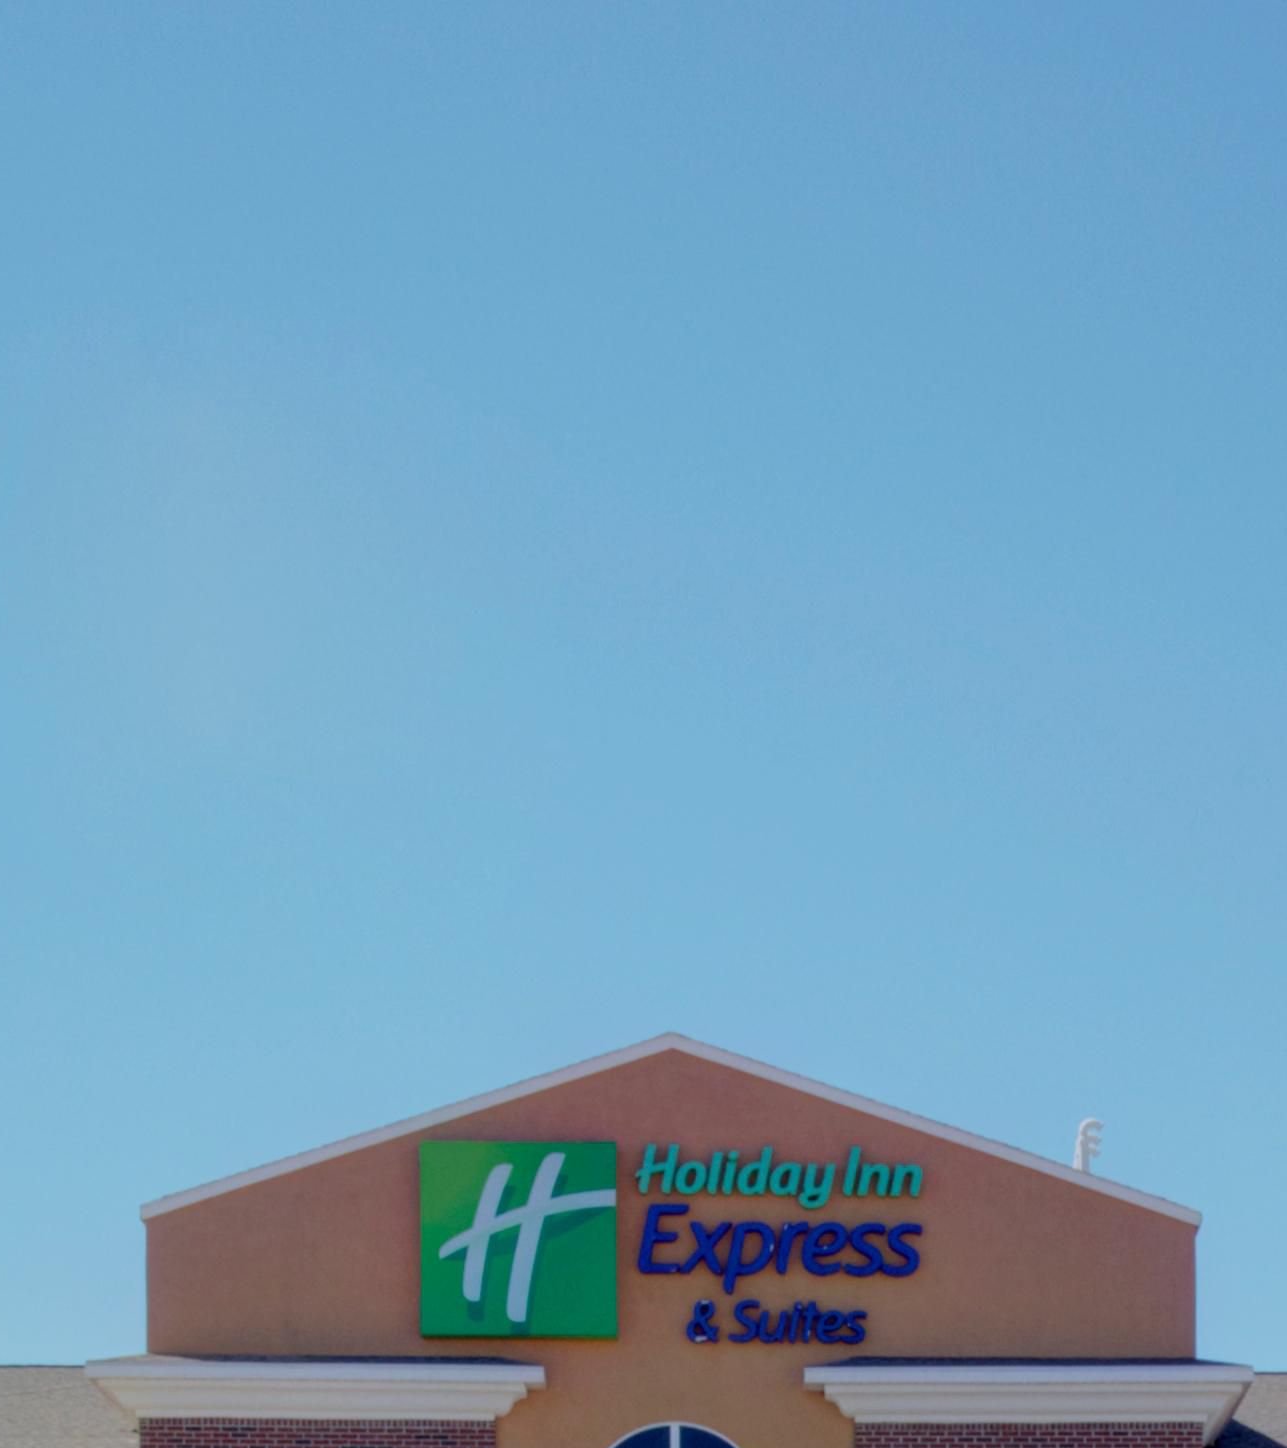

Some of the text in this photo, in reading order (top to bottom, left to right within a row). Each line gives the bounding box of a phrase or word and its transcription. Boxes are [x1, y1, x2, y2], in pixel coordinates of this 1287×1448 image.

[636, 1143, 924, 1209] Holiday Inn
[438, 1151, 617, 1323] H
[636, 1203, 923, 1295] Express
[685, 1299, 868, 1344] & Suites
